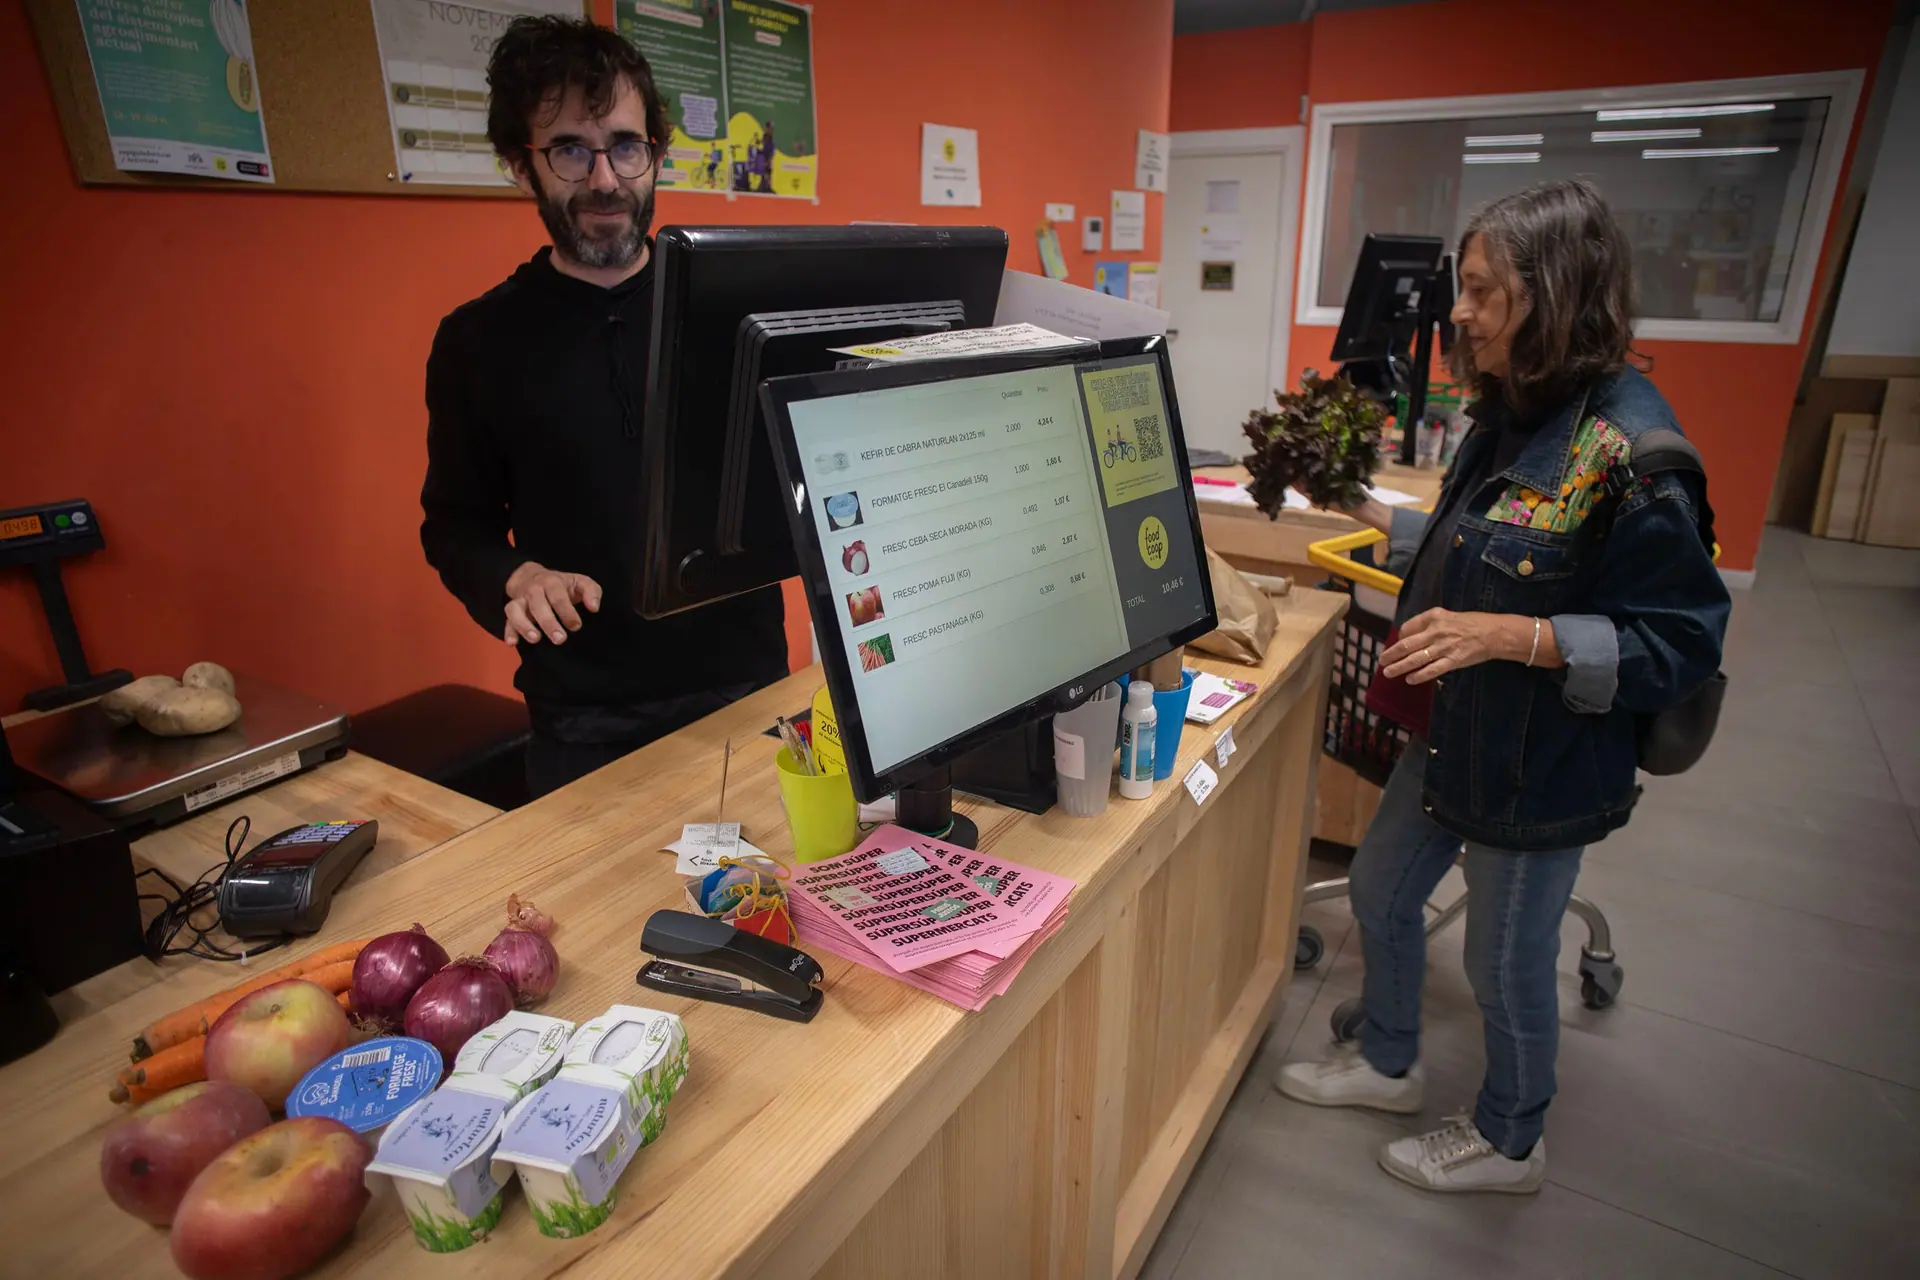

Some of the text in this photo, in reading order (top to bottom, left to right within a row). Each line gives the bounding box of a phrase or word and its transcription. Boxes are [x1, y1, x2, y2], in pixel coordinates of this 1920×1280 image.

[90, 8, 172, 33] del sistema
[429, 2, 512, 31] NOVEM
[93, 23, 200, 52] agroalimentari
[95, 37, 143, 53] actual
[860, 449, 884, 460] KEFIR
[885, 446, 896, 457] DE
[897, 442, 922, 454] CABRA
[922, 435, 958, 449] NATURLAN
[959, 430, 977, 442] 2x125
[977, 429, 986, 438] ml
[1005, 422, 1021, 433] 2,000
[1037, 417, 1049, 427] 4,24
[871, 490, 913, 508] FORMATGE
[914, 485, 938, 498] FRESC
[939, 483, 946, 492] El
[946, 477, 973, 490] Canadell
[974, 473, 989, 484] 150g
[1014, 463, 1030, 474] 1,000
[882, 541, 908, 555] FRESC
[908, 535, 929, 548] CEBA
[929, 529, 948, 542] SECA
[948, 521, 978, 536] MORADA
[978, 516, 993, 529] (KG)
[1023, 503, 1039, 515] 0,492
[1054, 496, 1065, 506] 1,07
[1145, 525, 1160, 546] food
[892, 586, 918, 600] FRESC
[918, 578, 940, 592] POMA
[940, 574, 956, 585] FUJI
[956, 568, 971, 579] (KG)
[1062, 535, 1073, 545] 2,87
[1147, 541, 1163, 560] coop
[1126, 594, 1146, 608] TOTAL
[1161, 579, 1179, 594] 10,46
[903, 630, 928, 646] FRESC
[928, 615, 968, 637] PASTANAGA
[969, 609, 984, 623] (KG)
[809, 861, 844, 874] SOM
[842, 847, 886, 866] SÚPER
[841, 882, 968, 921] SÚPERSÚPERSÚPER
[891, 912, 998, 947] SUPERMERCATS
[386, 1052, 406, 1100] FORMATGE
[401, 1059, 417, 1087] FRESC
[442, 1107, 492, 1164] naturlan
[565, 1098, 608, 1153] naturlan
